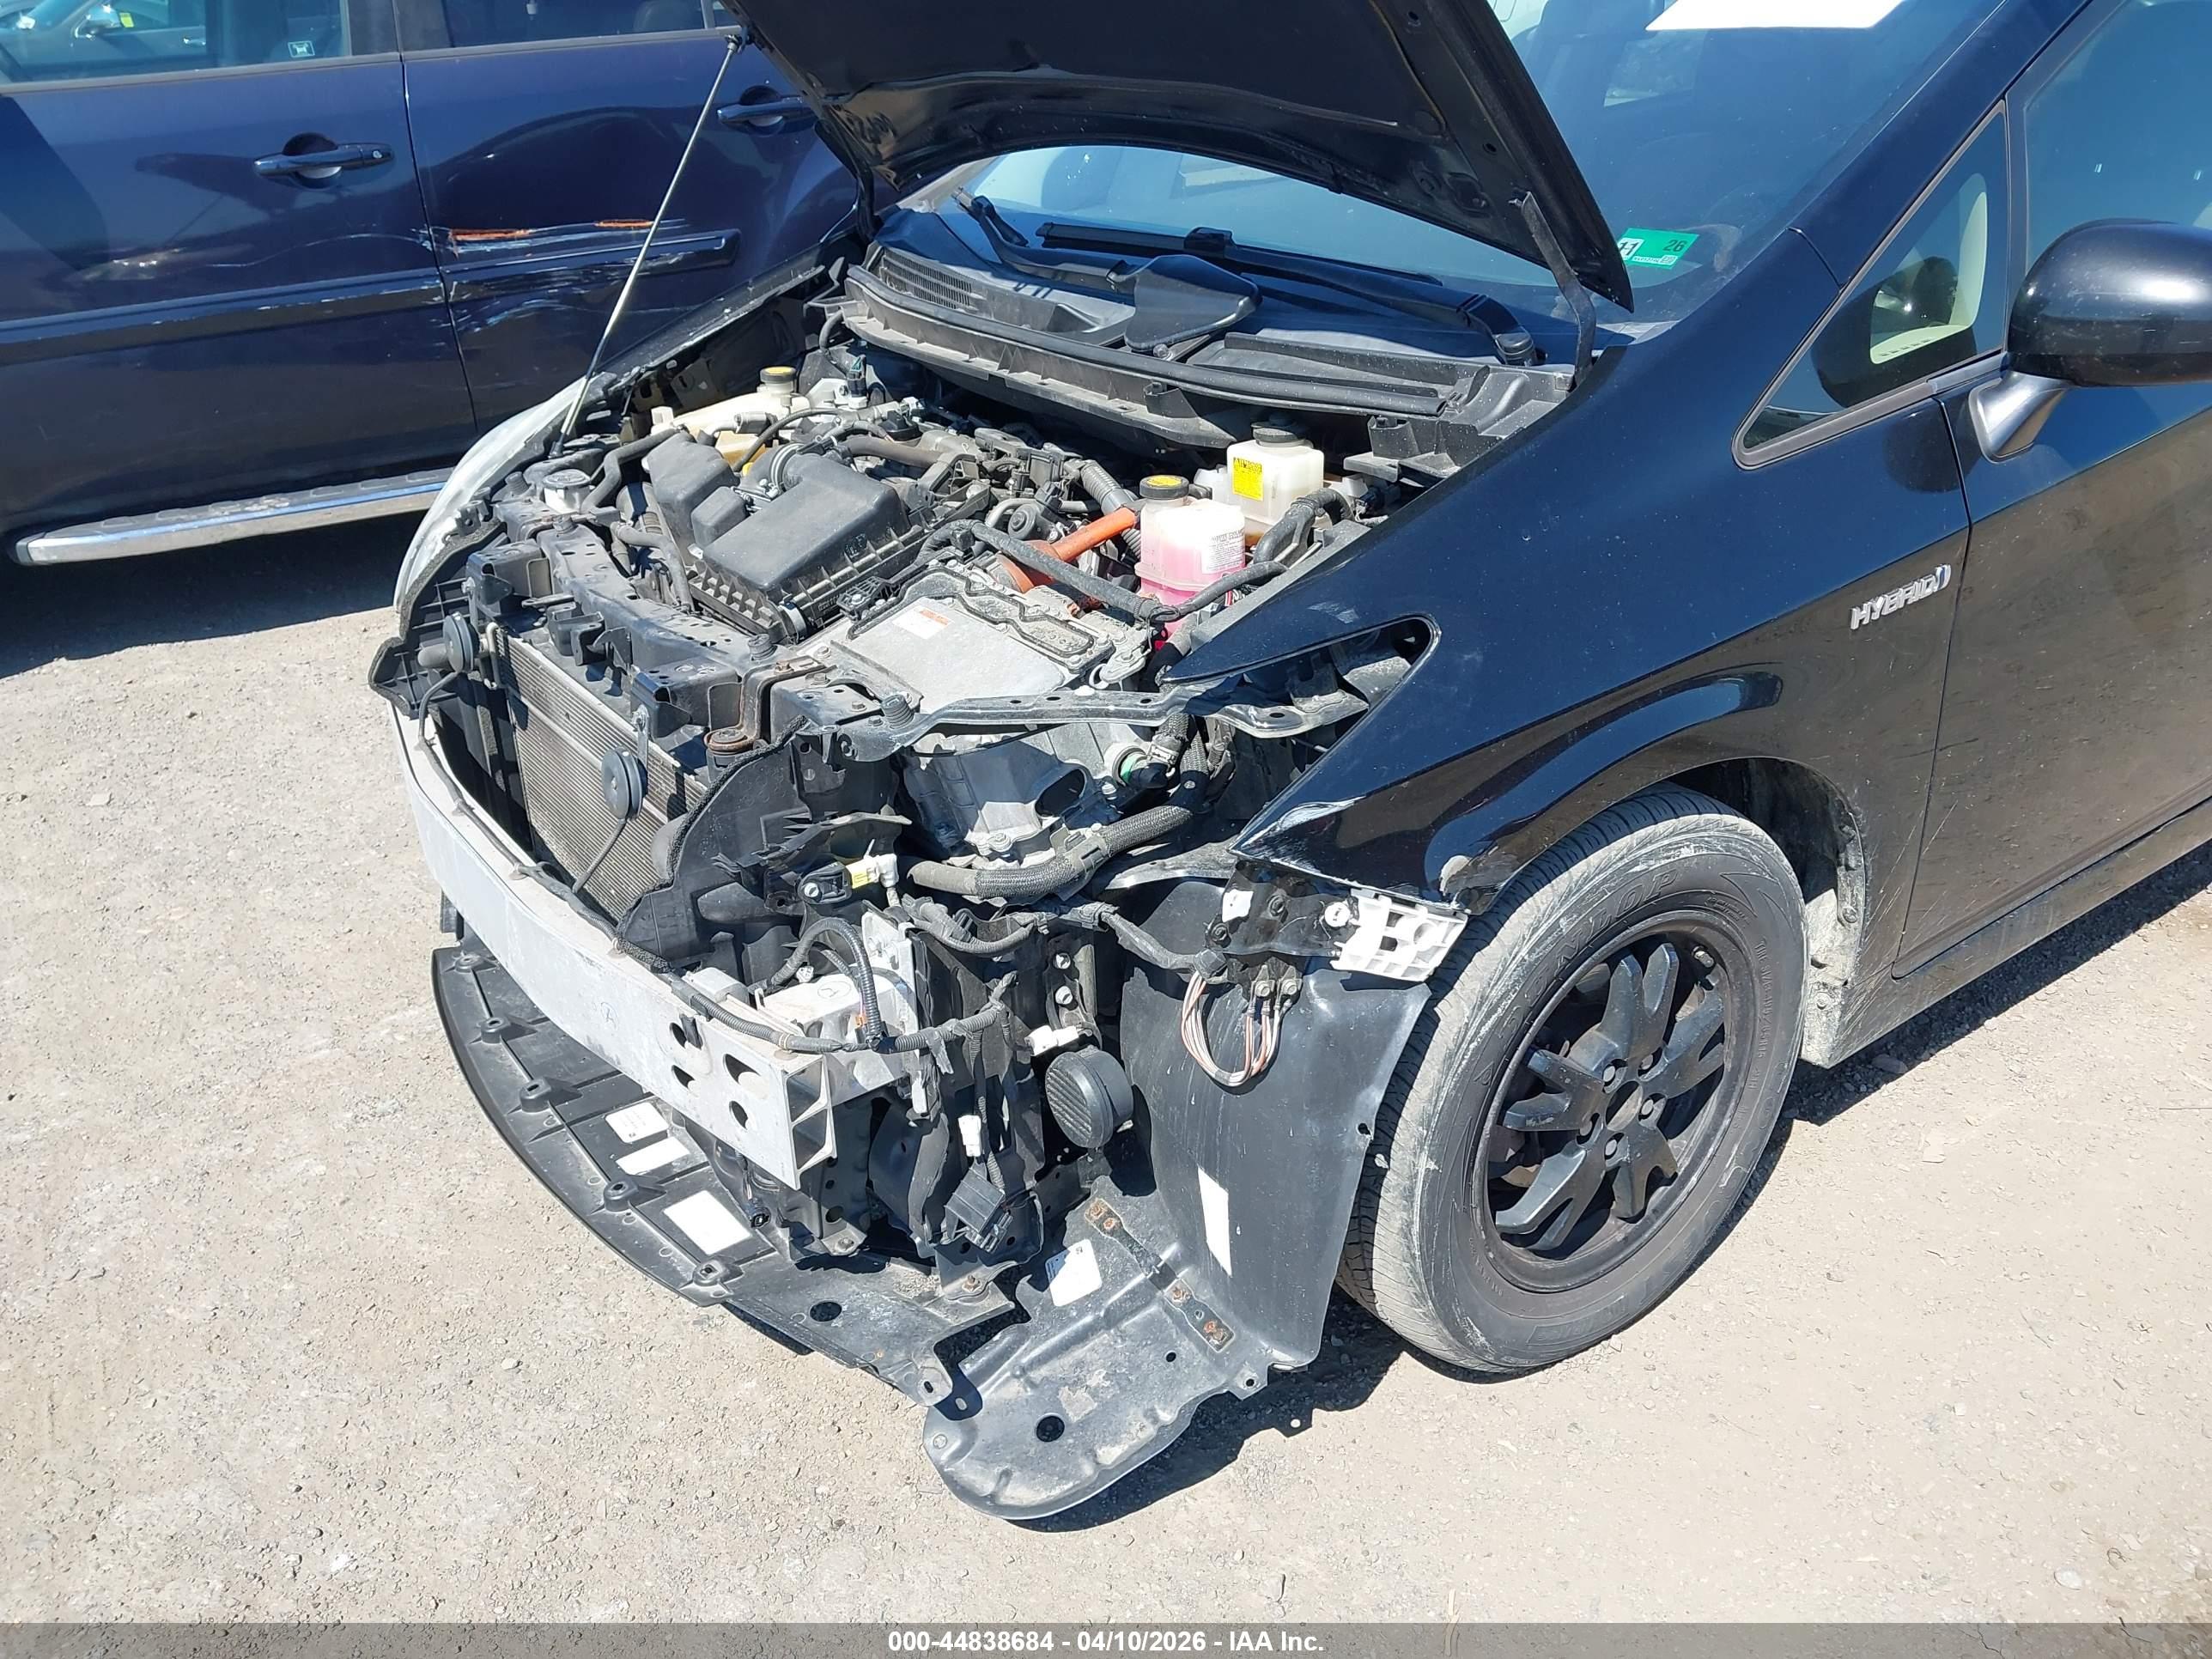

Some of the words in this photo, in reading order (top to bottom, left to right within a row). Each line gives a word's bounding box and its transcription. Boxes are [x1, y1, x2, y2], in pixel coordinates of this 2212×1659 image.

[1662, 239, 1687, 252] 26
[1850, 566, 1947, 630] HYBRID
[1498, 868, 1678, 1041] DUNLOP
